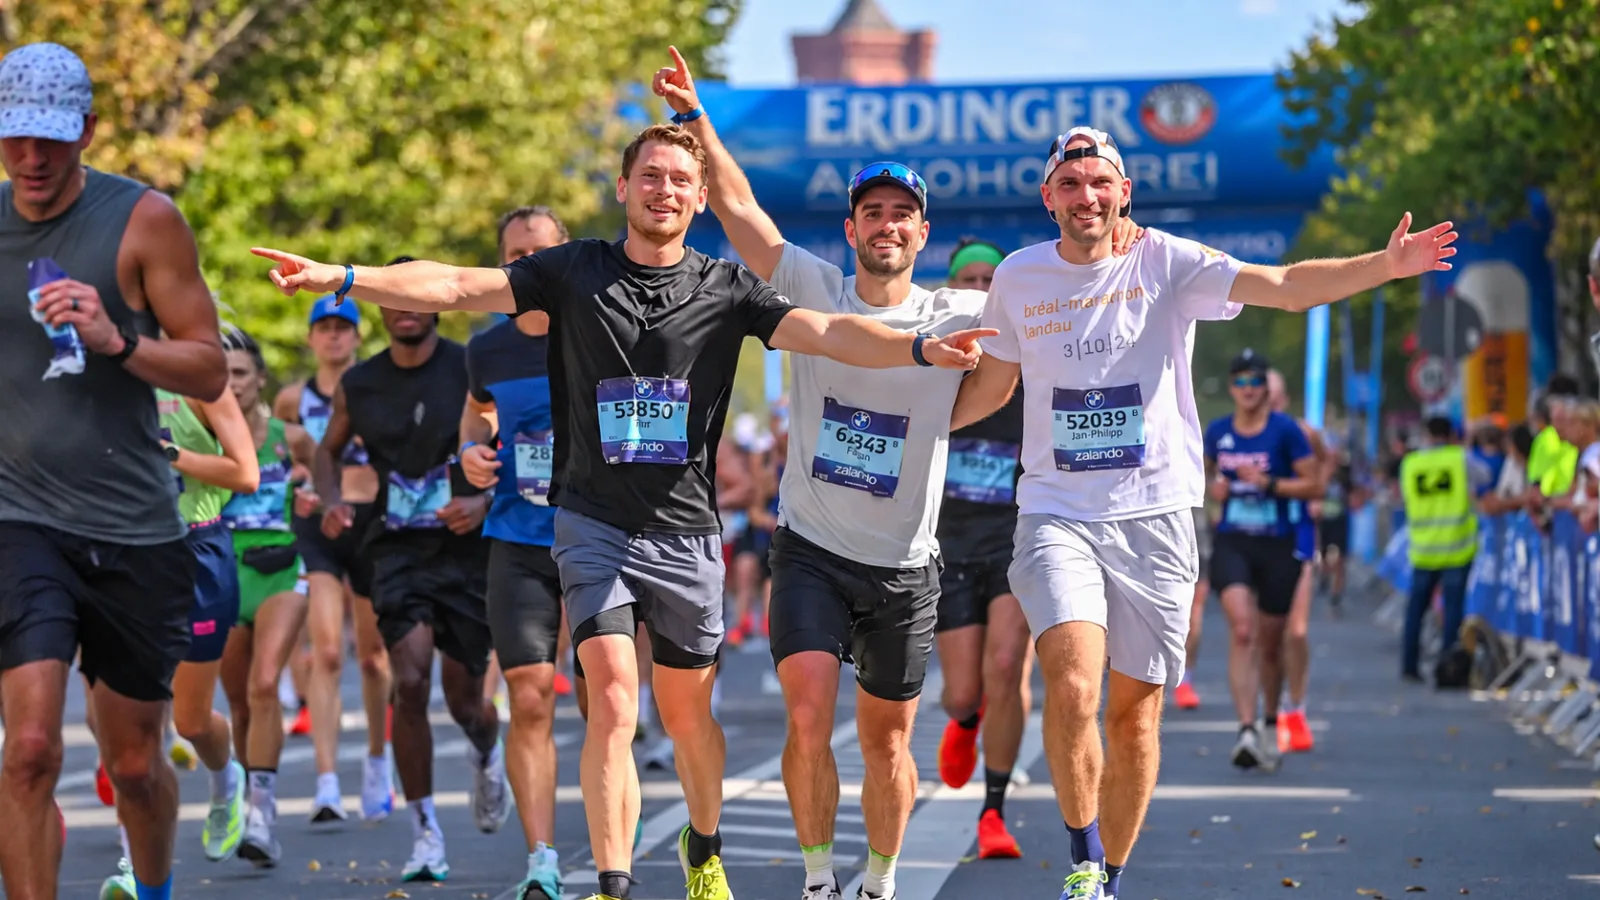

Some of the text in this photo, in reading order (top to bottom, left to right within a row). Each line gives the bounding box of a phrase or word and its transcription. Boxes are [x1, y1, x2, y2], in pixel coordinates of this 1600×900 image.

[805, 85, 1140, 152] ERDINGER
[1024, 286, 1144, 318] bréal-marathon
[1024, 320, 1072, 340] landau
[614, 401, 673, 420] 53850
[1066, 408, 1139, 430] 52039 B
[1072, 429, 1123, 441] Jan-Philipp
[1075, 447, 1124, 461] zalando
